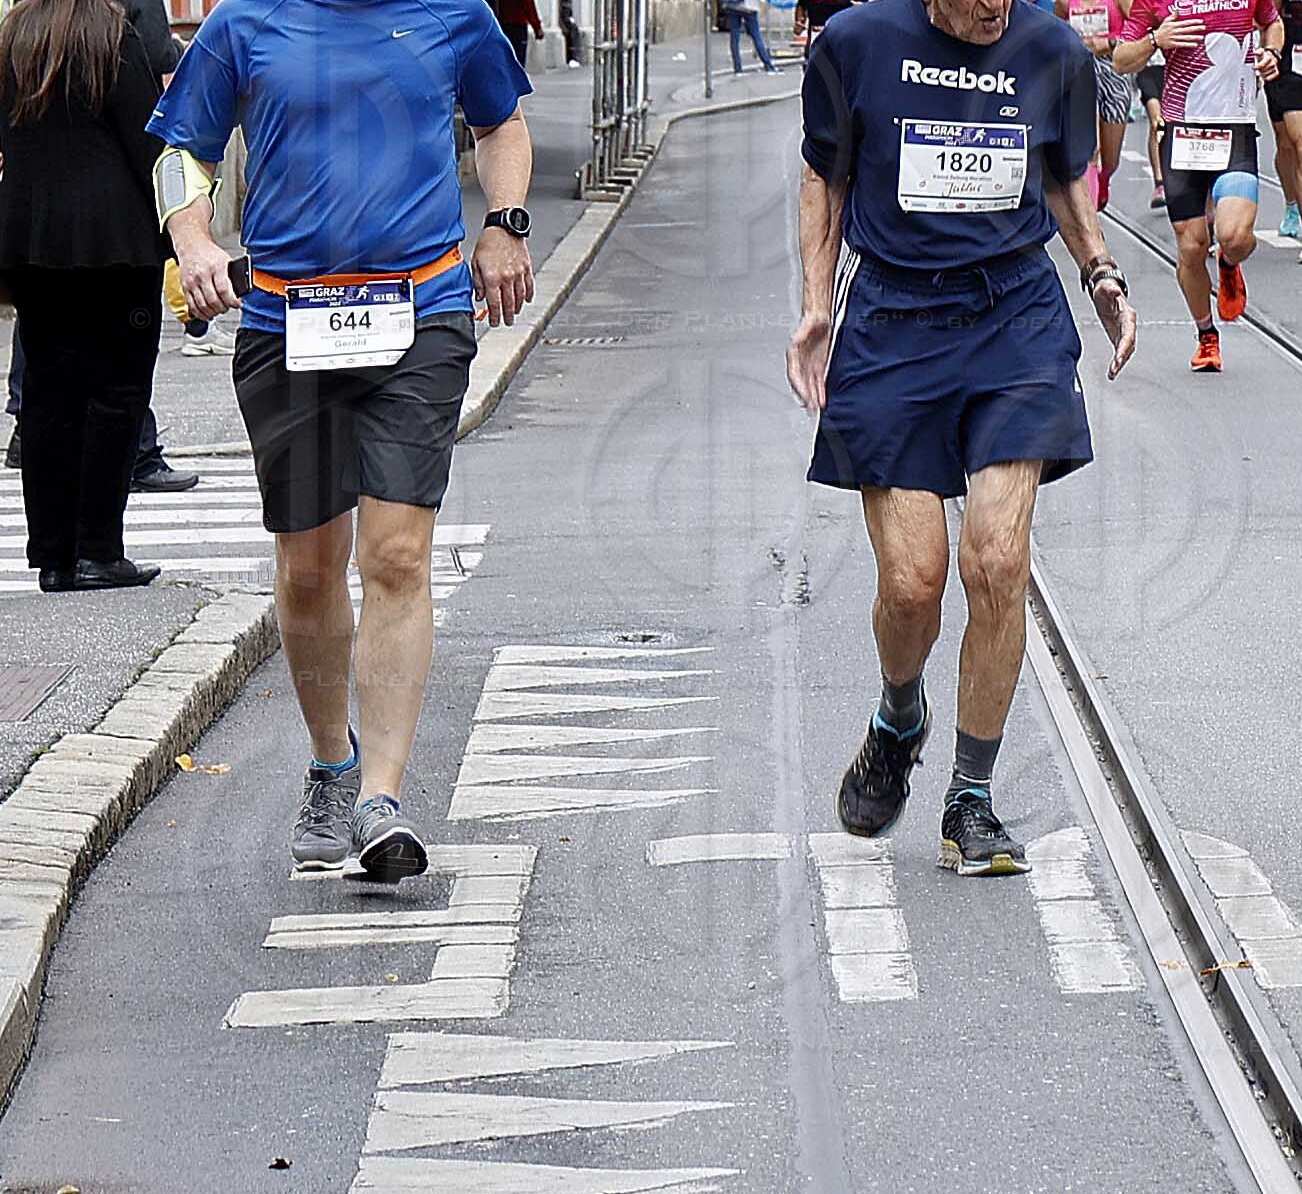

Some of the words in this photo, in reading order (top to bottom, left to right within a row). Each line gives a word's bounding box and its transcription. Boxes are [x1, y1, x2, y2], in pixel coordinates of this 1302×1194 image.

[1192, 0, 1250, 15] TRIATHLON
[901, 59, 1017, 95] Reebok
[932, 125, 963, 137] GRAZ
[936, 150, 993, 174] 1820
[316, 286, 346, 297] GRAZ
[329, 310, 372, 332] 644
